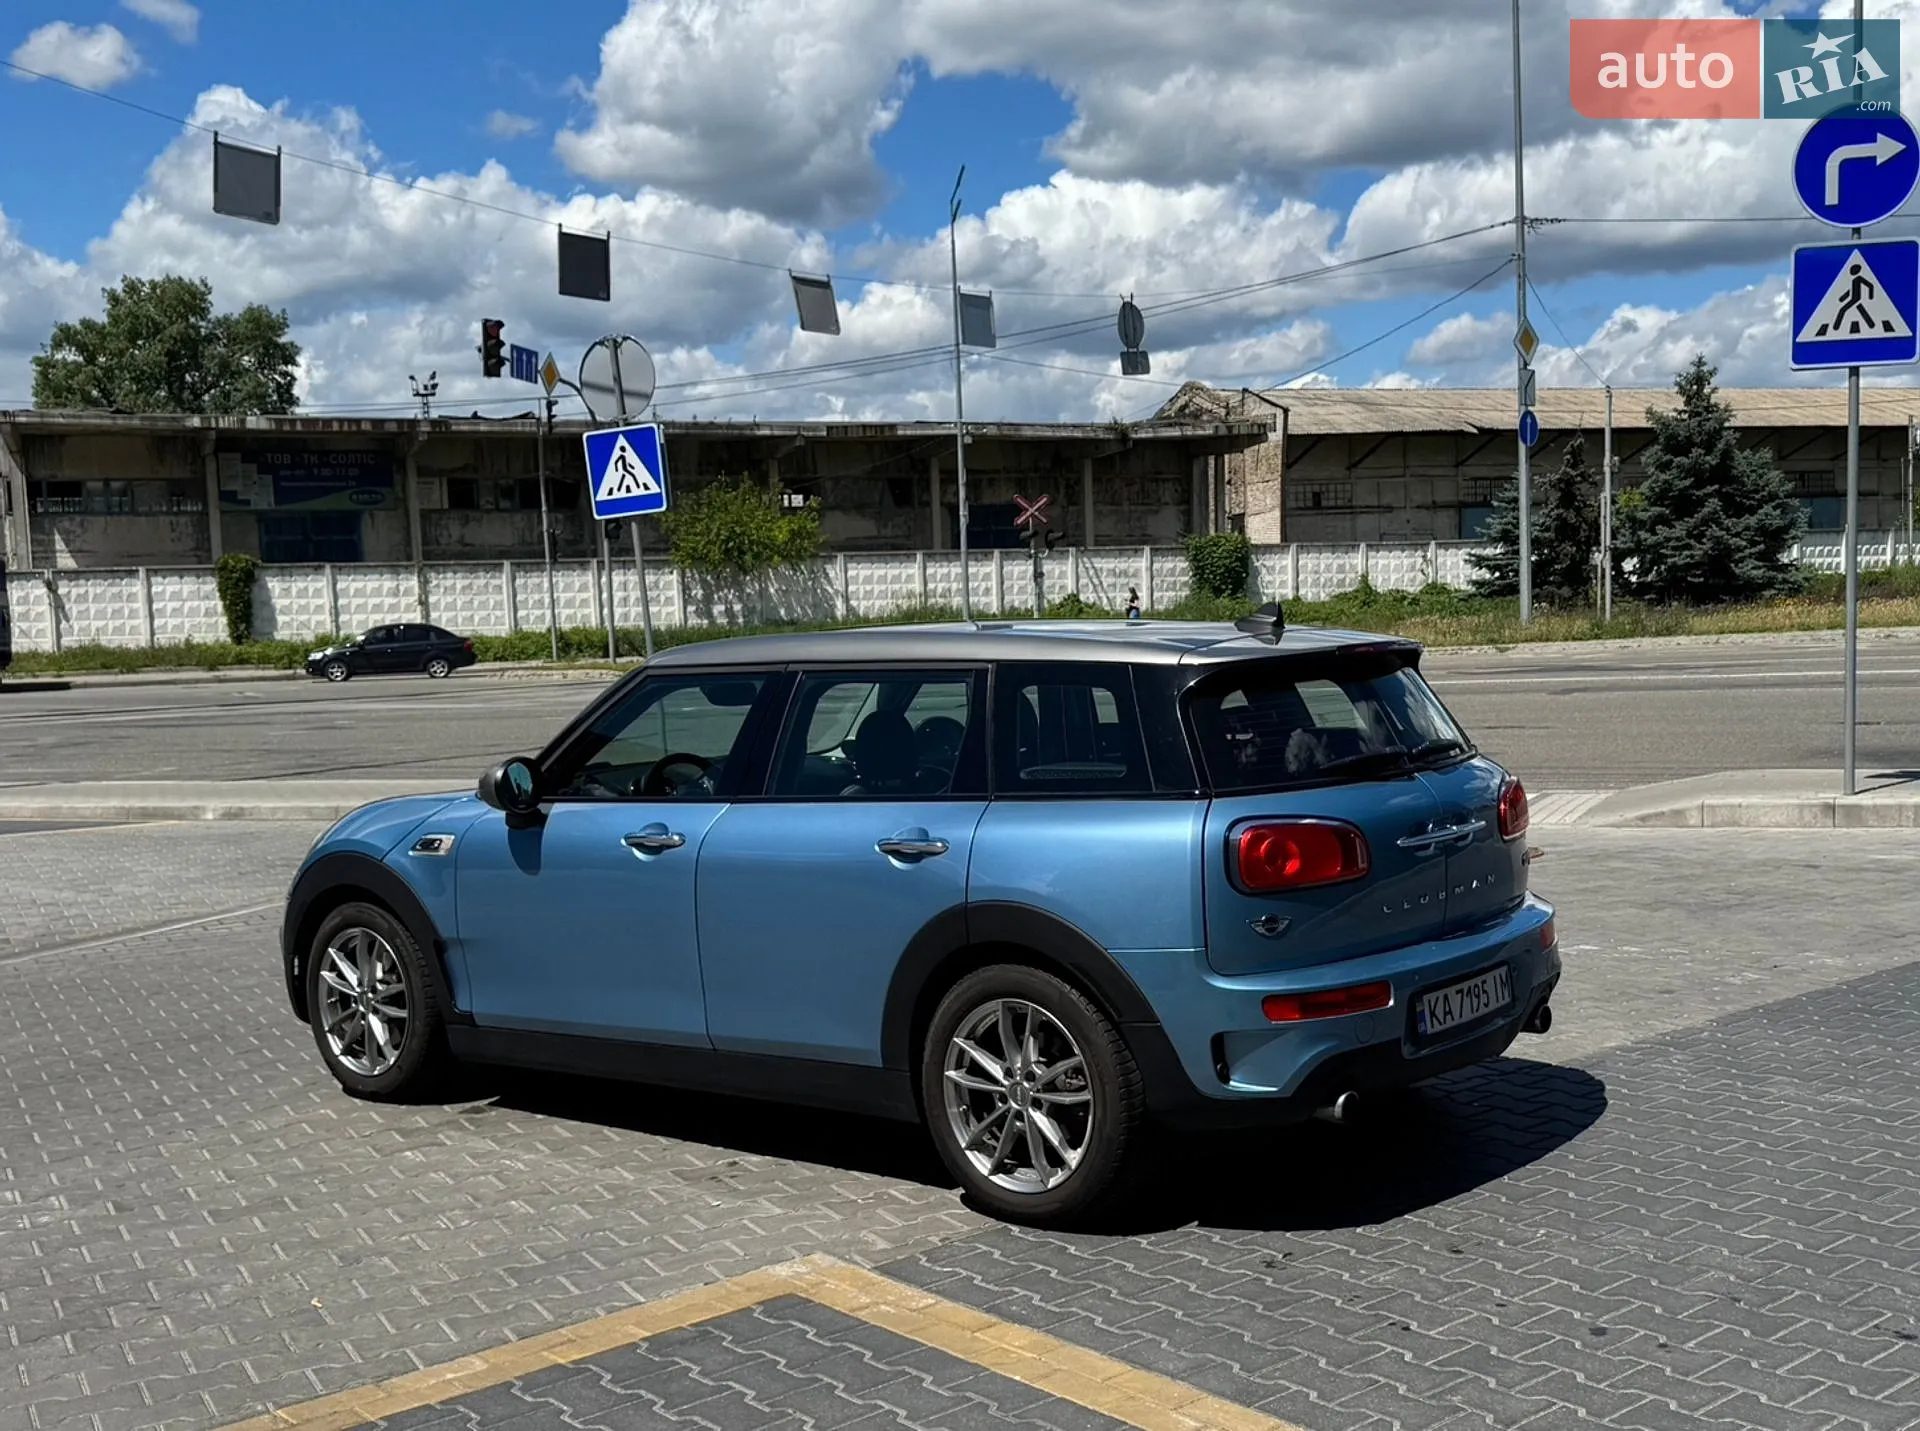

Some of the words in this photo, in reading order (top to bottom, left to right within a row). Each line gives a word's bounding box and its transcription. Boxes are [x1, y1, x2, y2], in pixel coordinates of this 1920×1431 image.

[1382, 874, 1496, 913] CLUBMAN
[1428, 994, 1455, 1028] KA
[1456, 981, 1490, 1019] 7195
[1493, 970, 1512, 1003] IM
